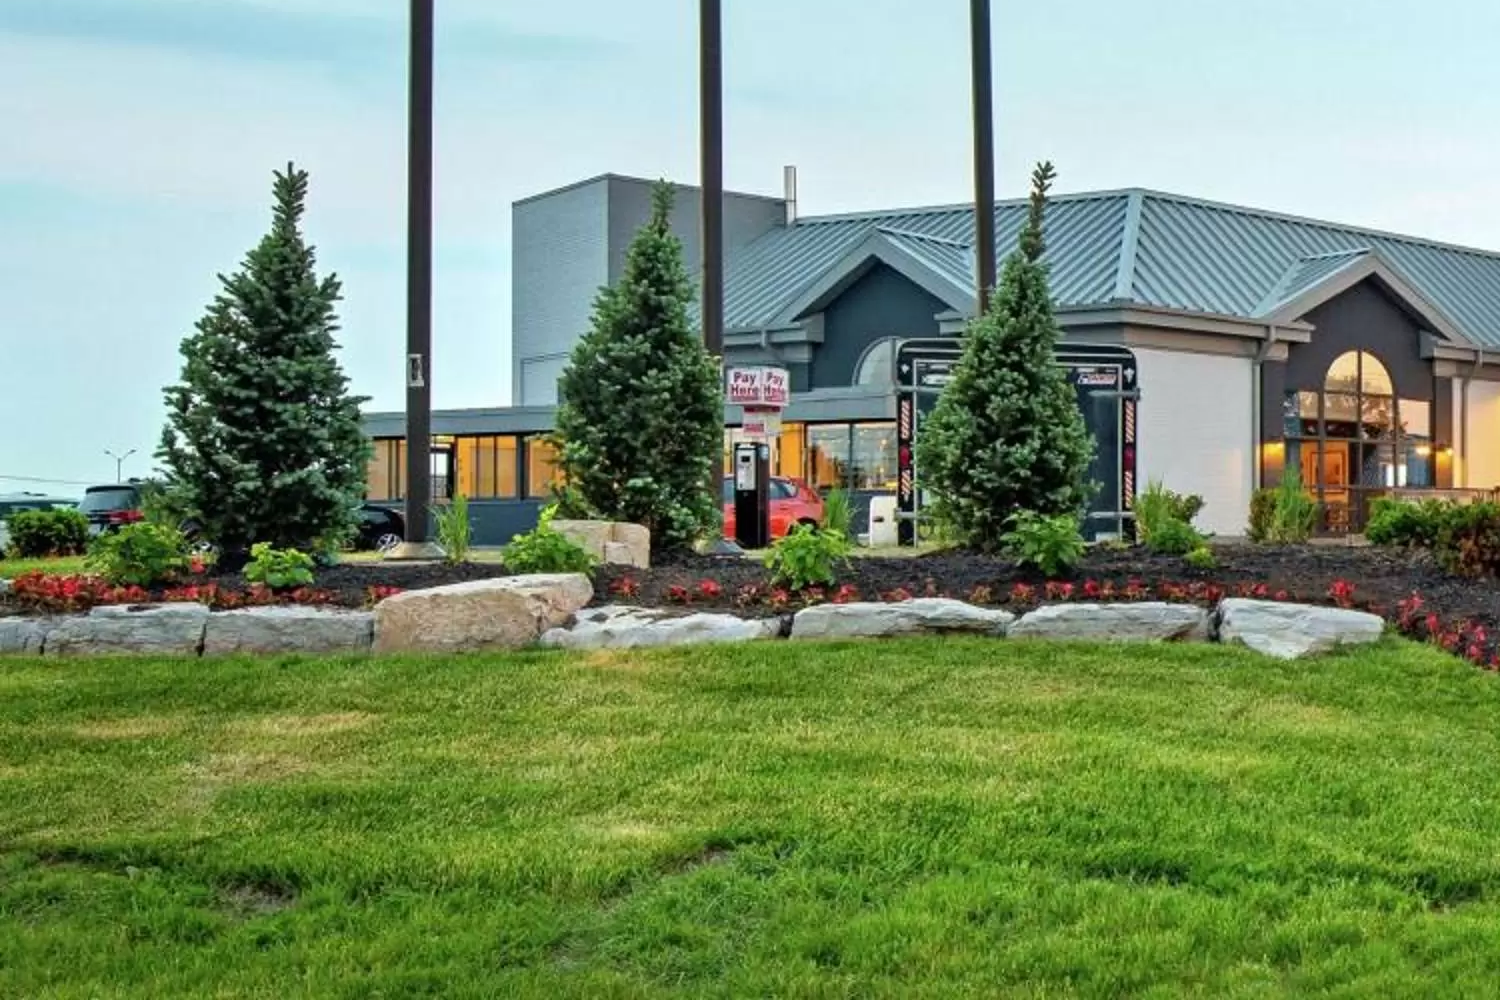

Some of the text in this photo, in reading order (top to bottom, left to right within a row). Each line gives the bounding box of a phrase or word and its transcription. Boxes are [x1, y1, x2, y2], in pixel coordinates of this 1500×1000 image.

[734, 371, 756, 386] Pay
[767, 371, 784, 386] Pay
[731, 383, 758, 396] Here
